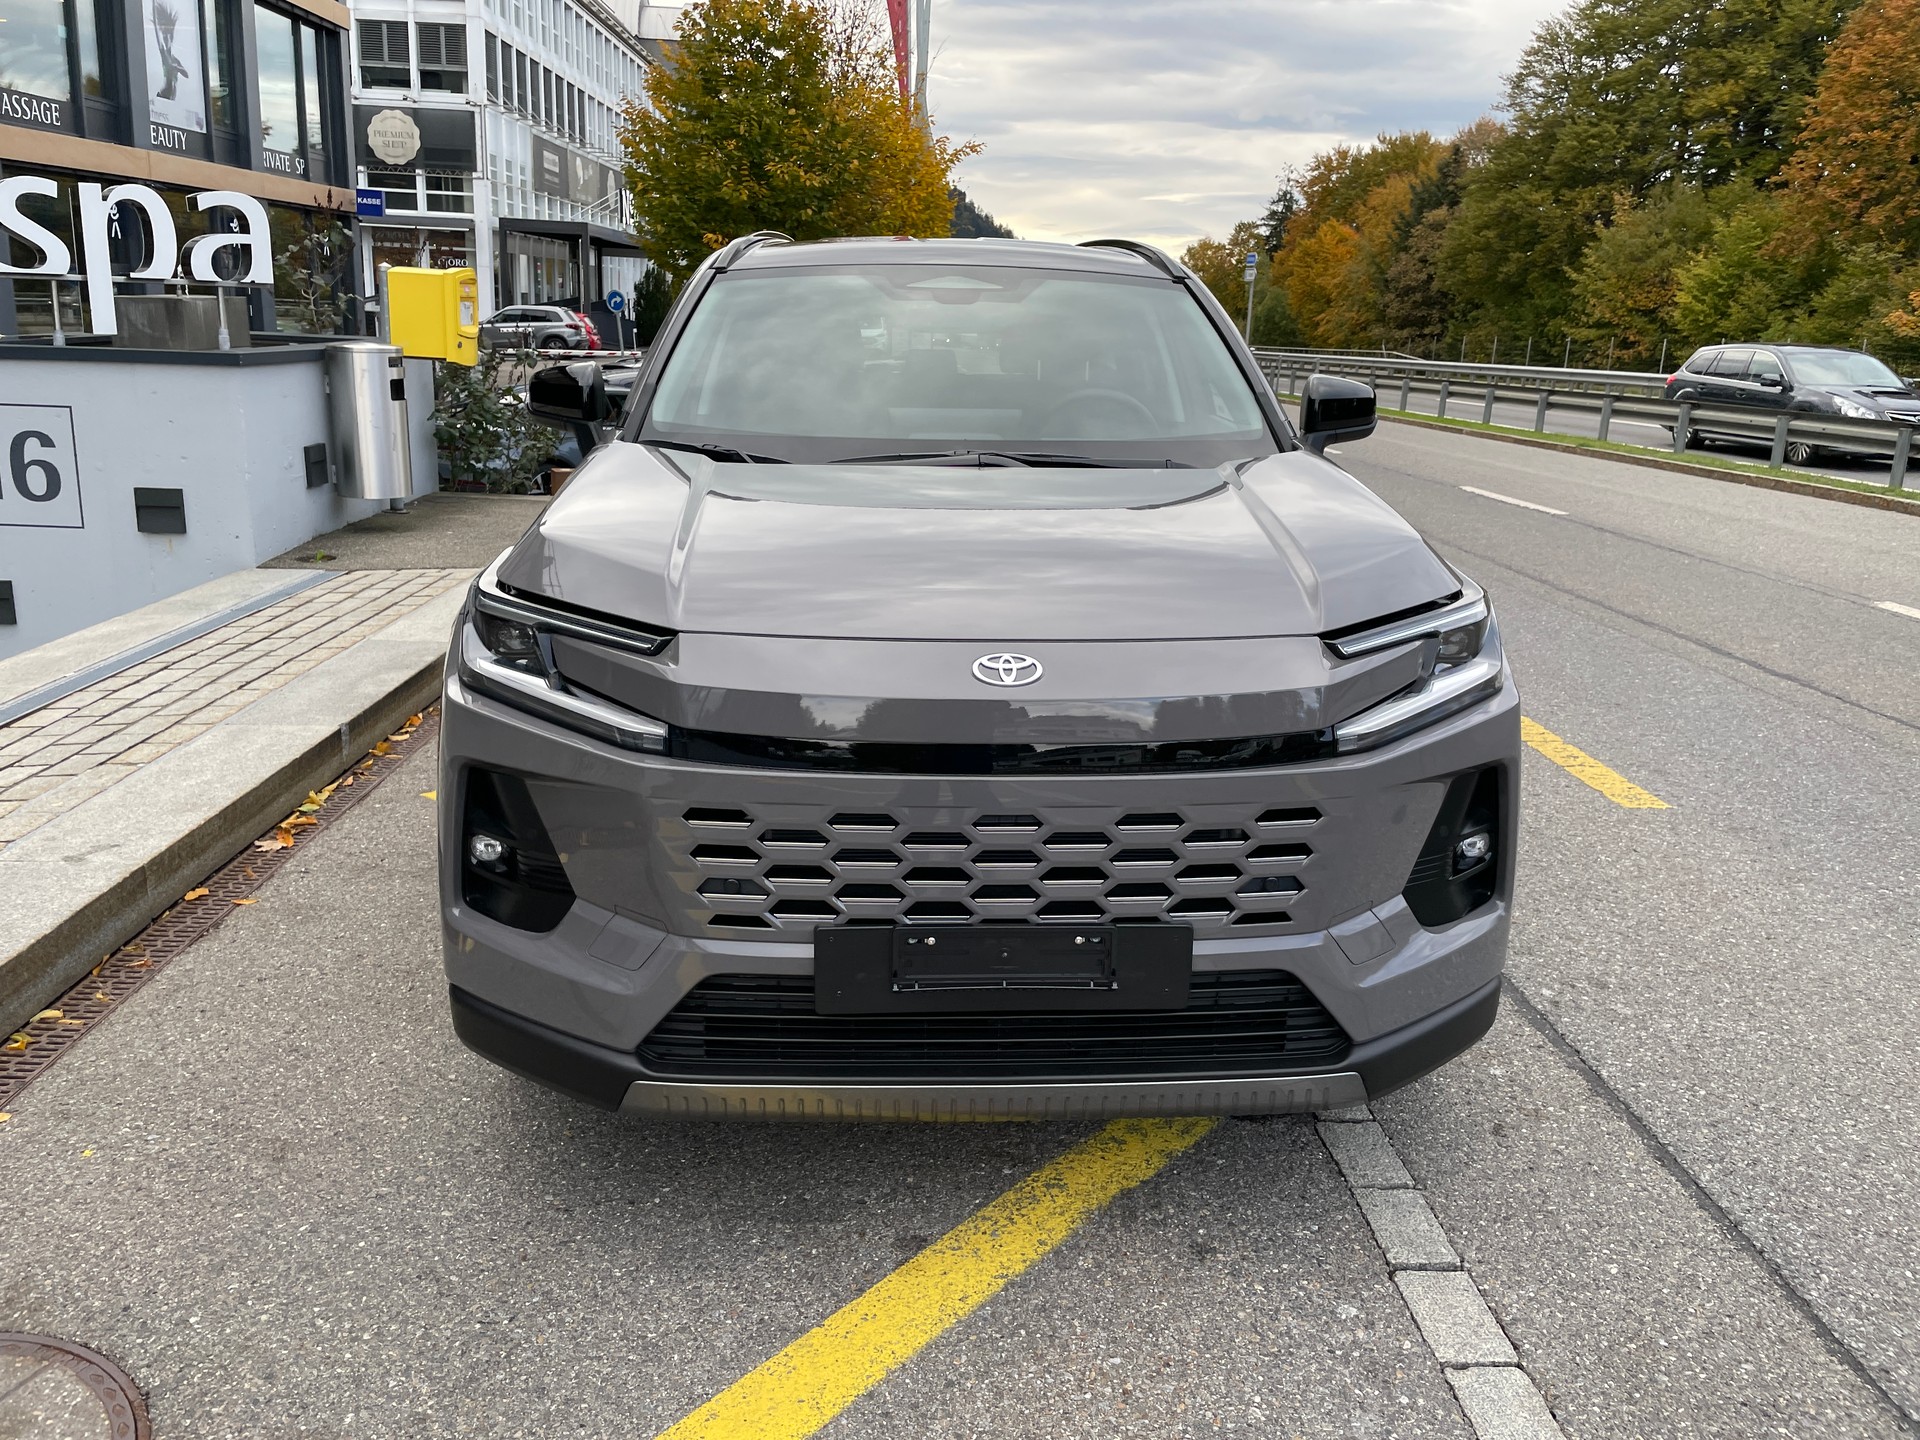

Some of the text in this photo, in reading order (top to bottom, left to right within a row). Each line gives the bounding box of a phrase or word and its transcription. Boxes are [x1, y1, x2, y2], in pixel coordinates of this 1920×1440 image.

[1, 92, 61, 126] ASSAGE
[150, 124, 187, 150] EAUTY
[357, 196, 381, 206] KASSE
[0, 175, 274, 335] spa
[0, 429, 62, 502] 6
